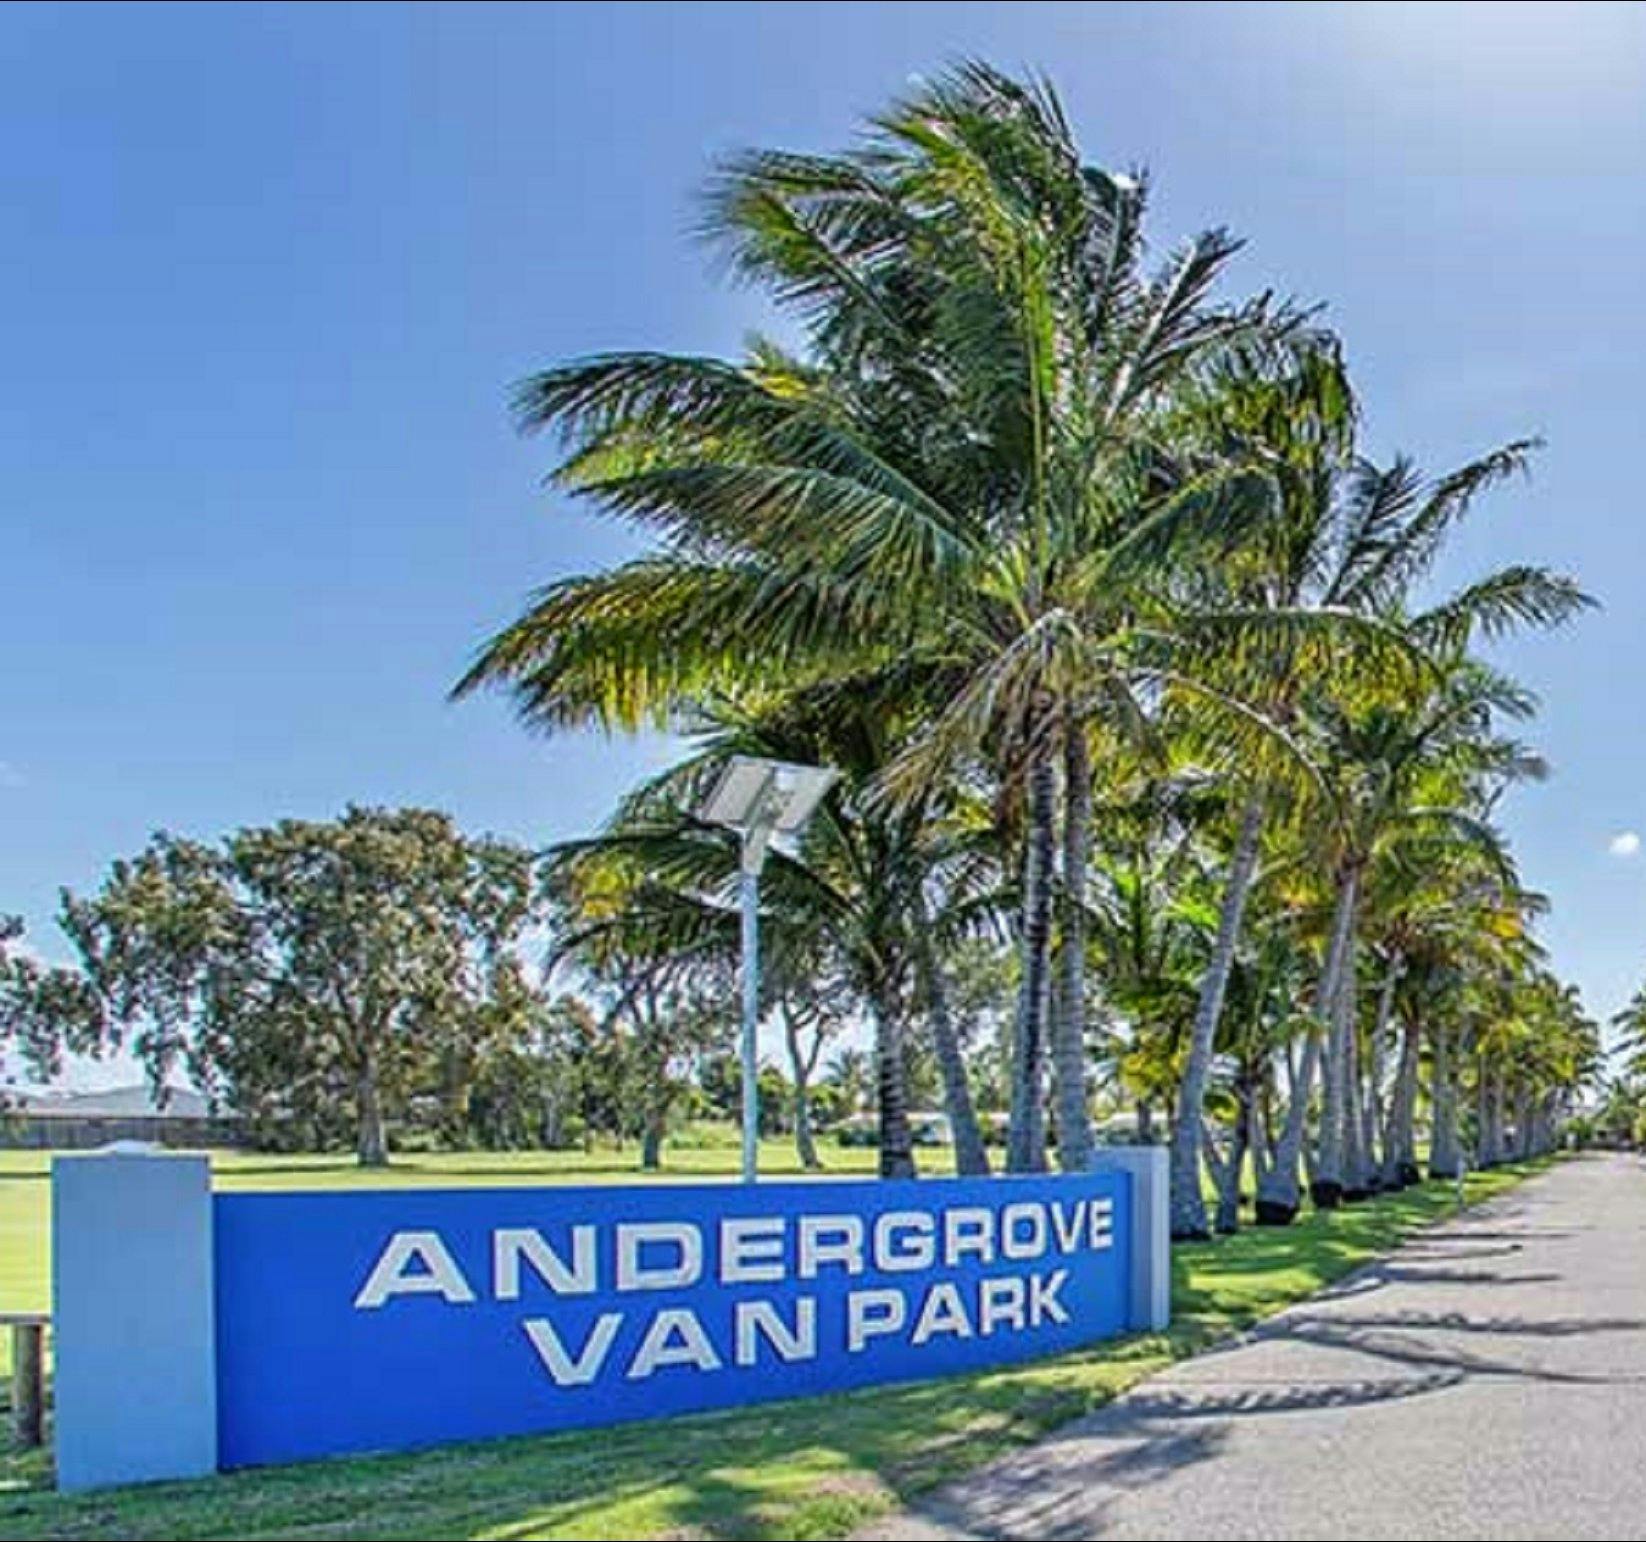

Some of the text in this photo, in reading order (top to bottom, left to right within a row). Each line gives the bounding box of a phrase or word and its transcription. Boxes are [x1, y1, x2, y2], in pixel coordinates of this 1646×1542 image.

[355, 1199, 1113, 1307] ANDERGROVE
[523, 1269, 1070, 1386] VAN PARK
